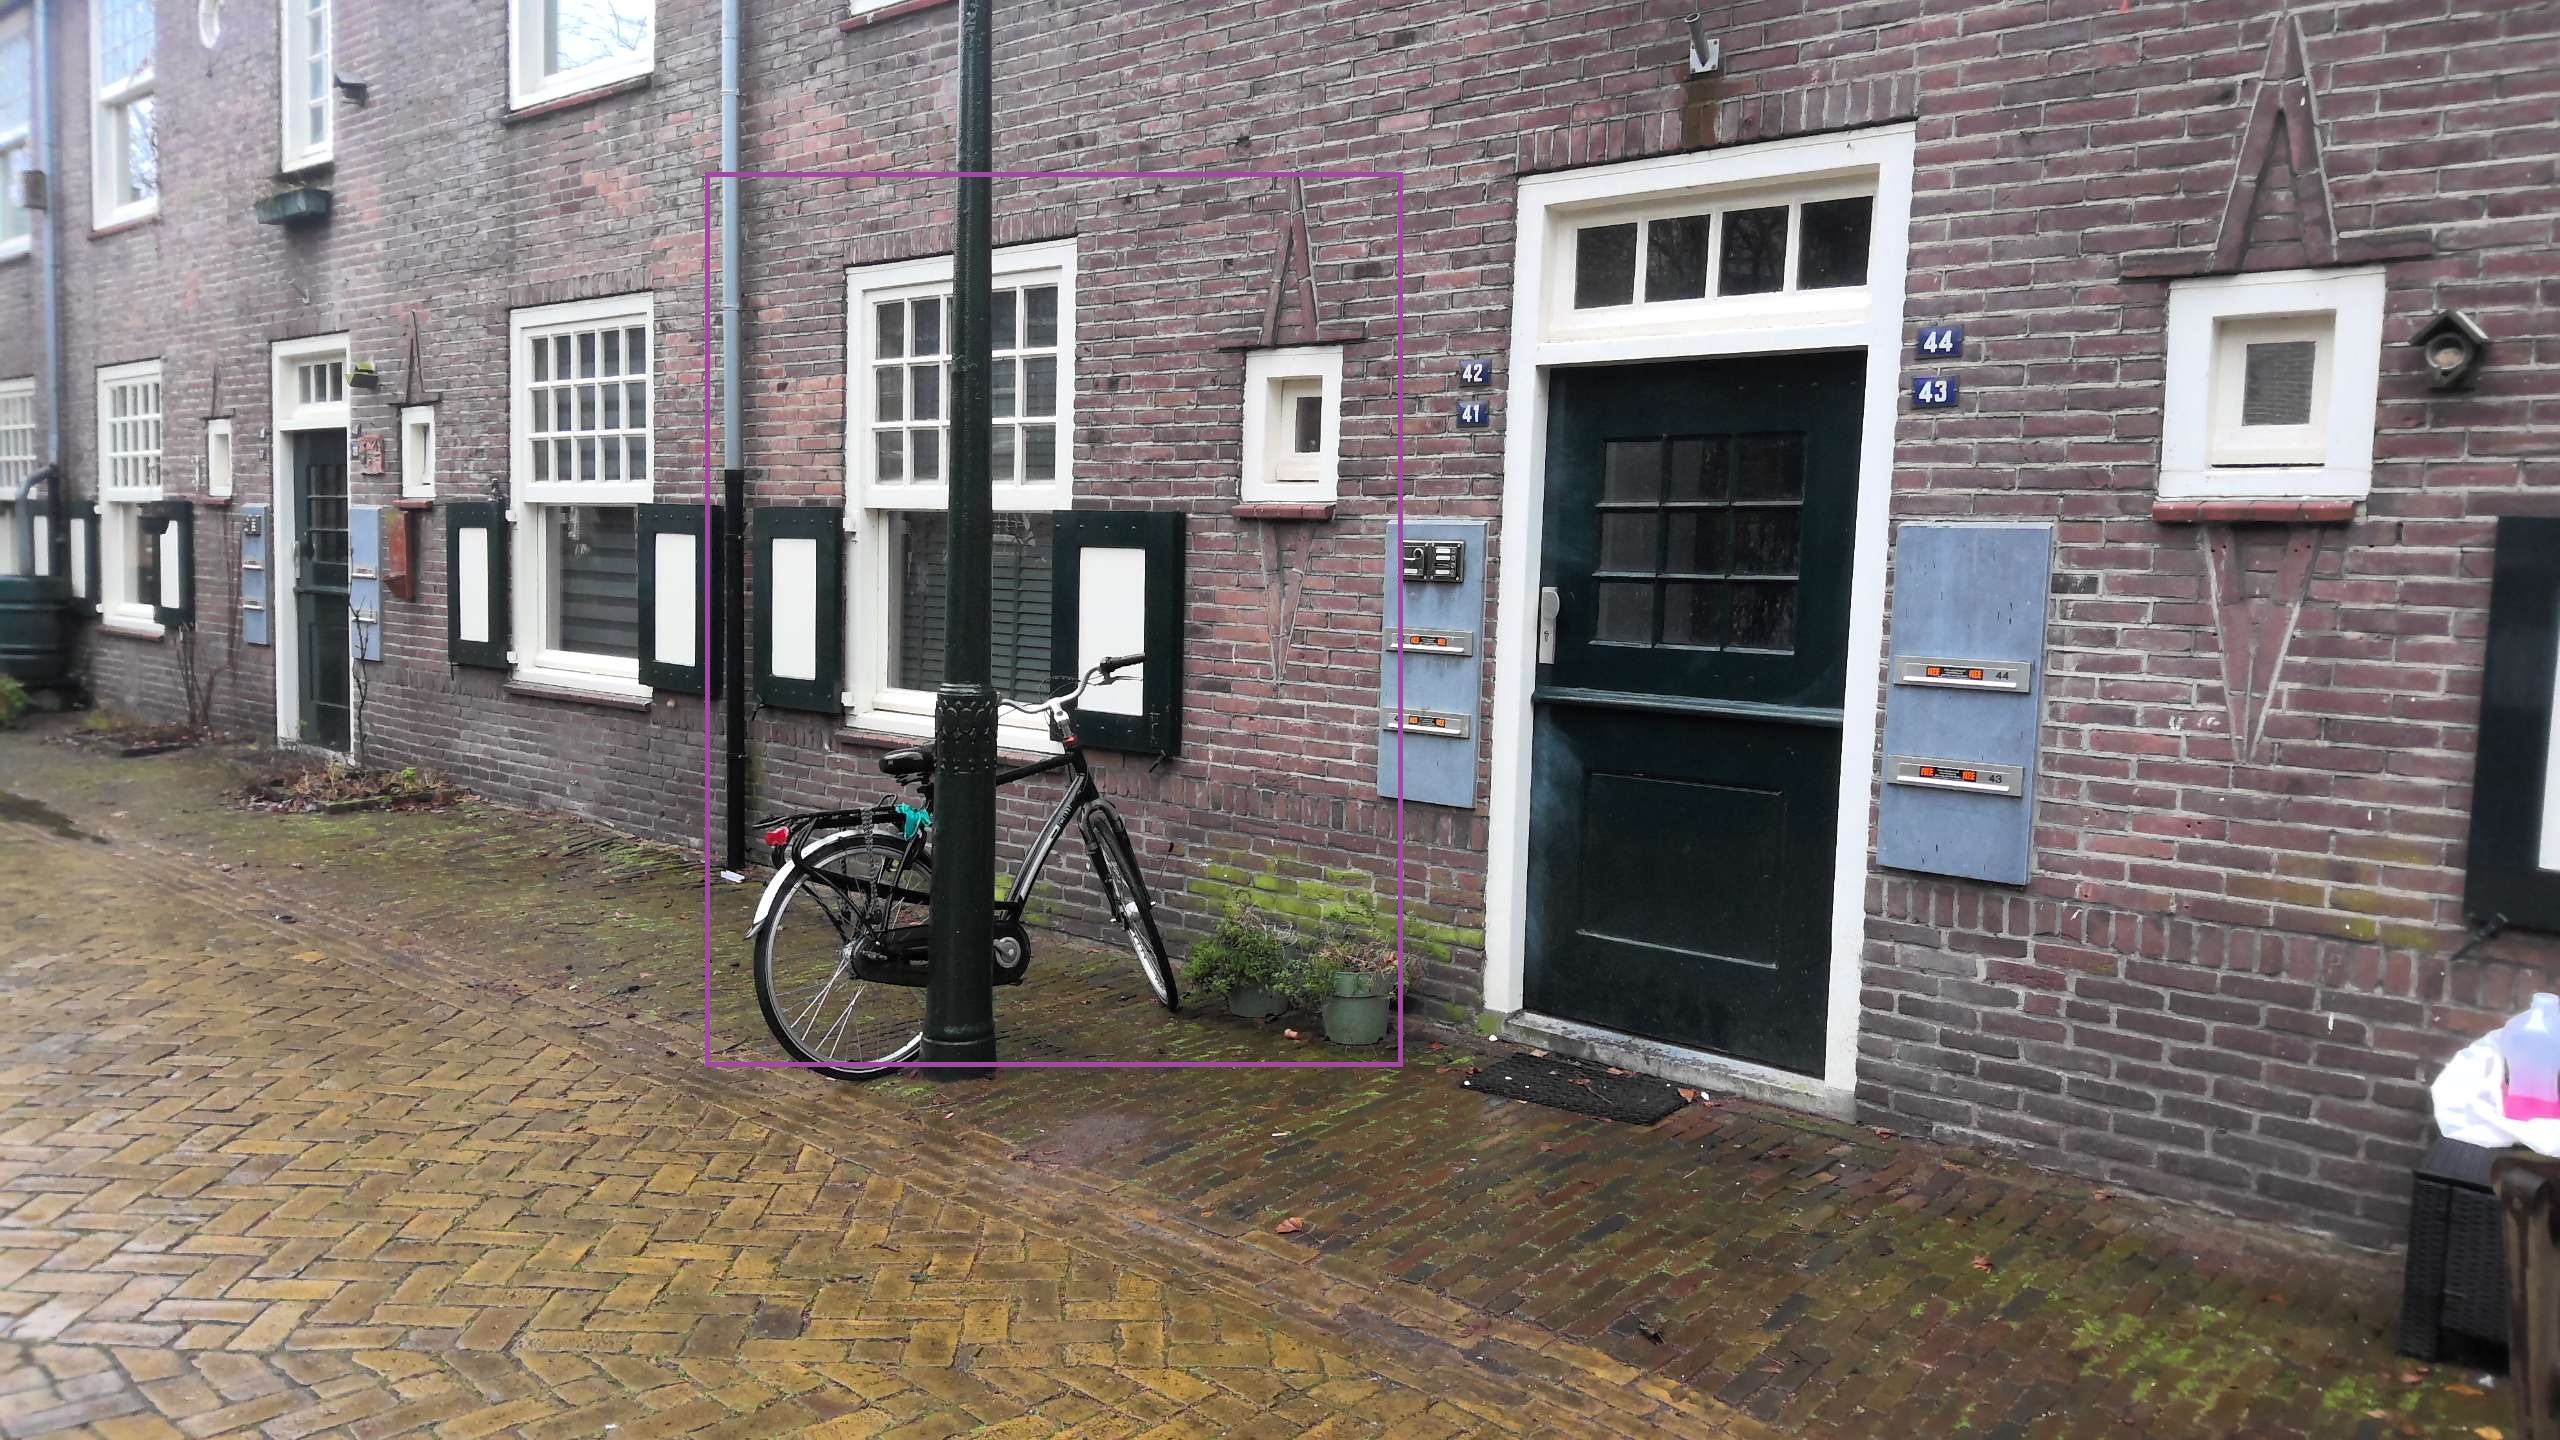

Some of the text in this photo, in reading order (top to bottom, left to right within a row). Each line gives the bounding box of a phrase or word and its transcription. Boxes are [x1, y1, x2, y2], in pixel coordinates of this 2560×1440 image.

[1924, 330, 1953, 352] 44
[1463, 364, 1482, 382] 42
[1919, 380, 1947, 403] 43
[1463, 404, 1480, 422] 41
[1995, 671, 2009, 680] 44
[1988, 774, 2002, 783] 43
